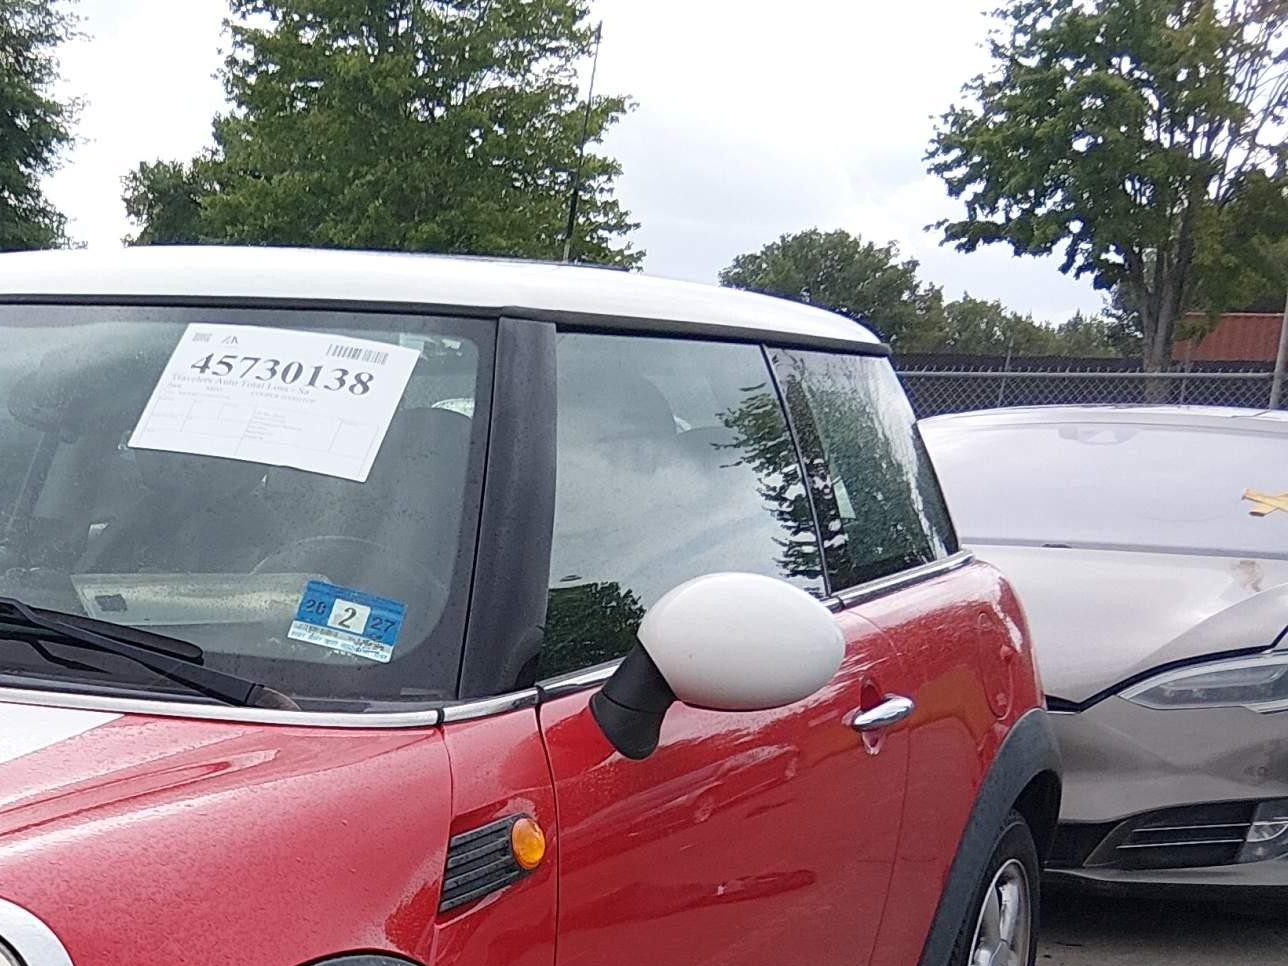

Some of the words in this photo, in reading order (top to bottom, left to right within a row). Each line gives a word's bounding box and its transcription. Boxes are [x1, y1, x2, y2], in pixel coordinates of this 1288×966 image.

[190, 352, 375, 396] 45730138
[337, 607, 357, 629] 2
[371, 616, 396, 633] 27
